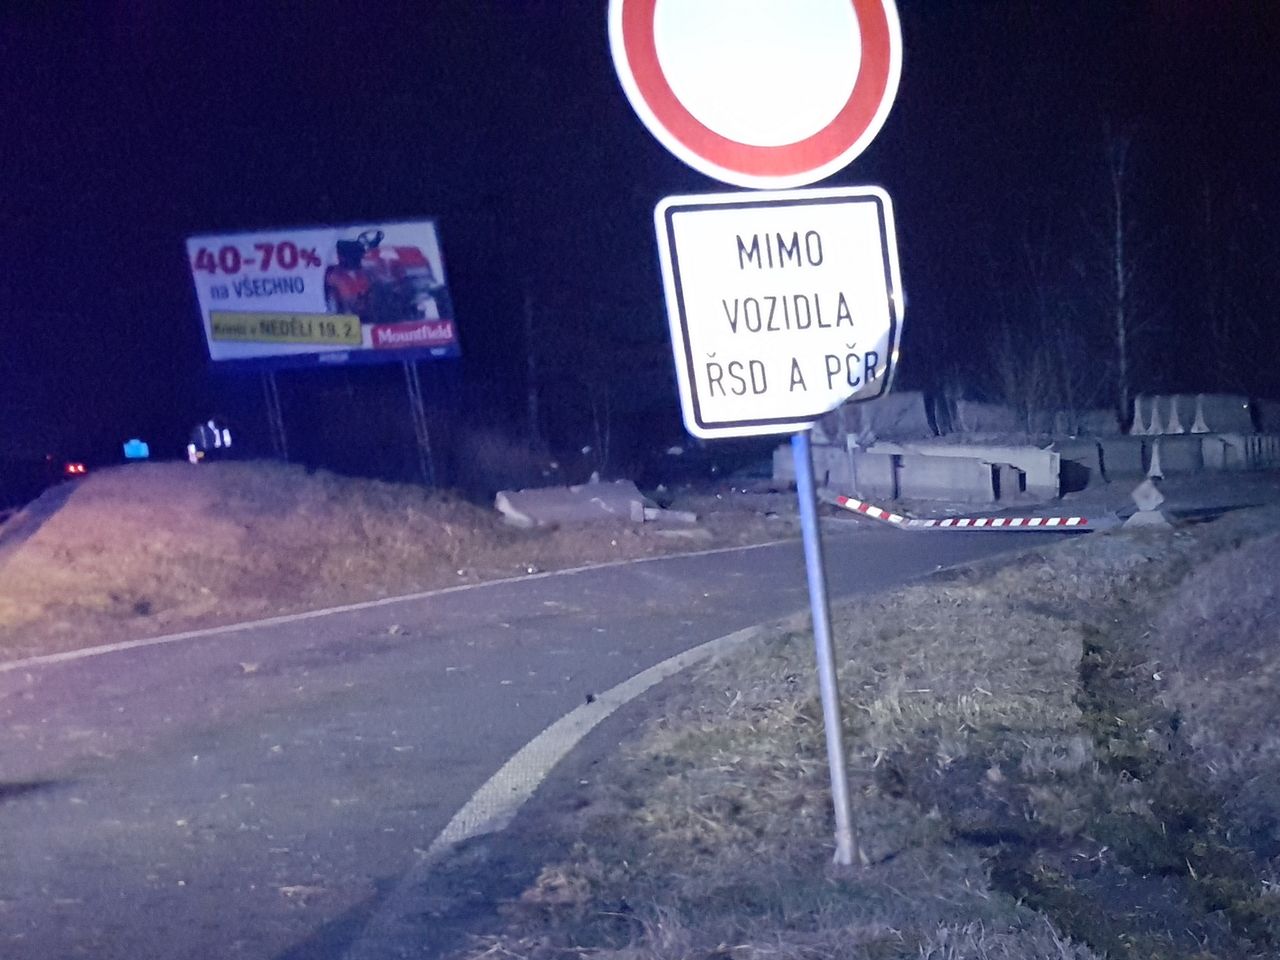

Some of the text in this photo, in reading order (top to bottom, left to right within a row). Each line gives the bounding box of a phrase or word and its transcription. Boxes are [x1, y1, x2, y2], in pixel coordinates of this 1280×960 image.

[194, 241, 322, 276] 40-70%
[736, 230, 824, 270] MIMO
[210, 273, 306, 299] na VŠECHNO
[723, 291, 854, 333] VOZIDLA
[377, 322, 452, 344] Mountfield
[706, 342, 879, 397] ŘSD A PČR
